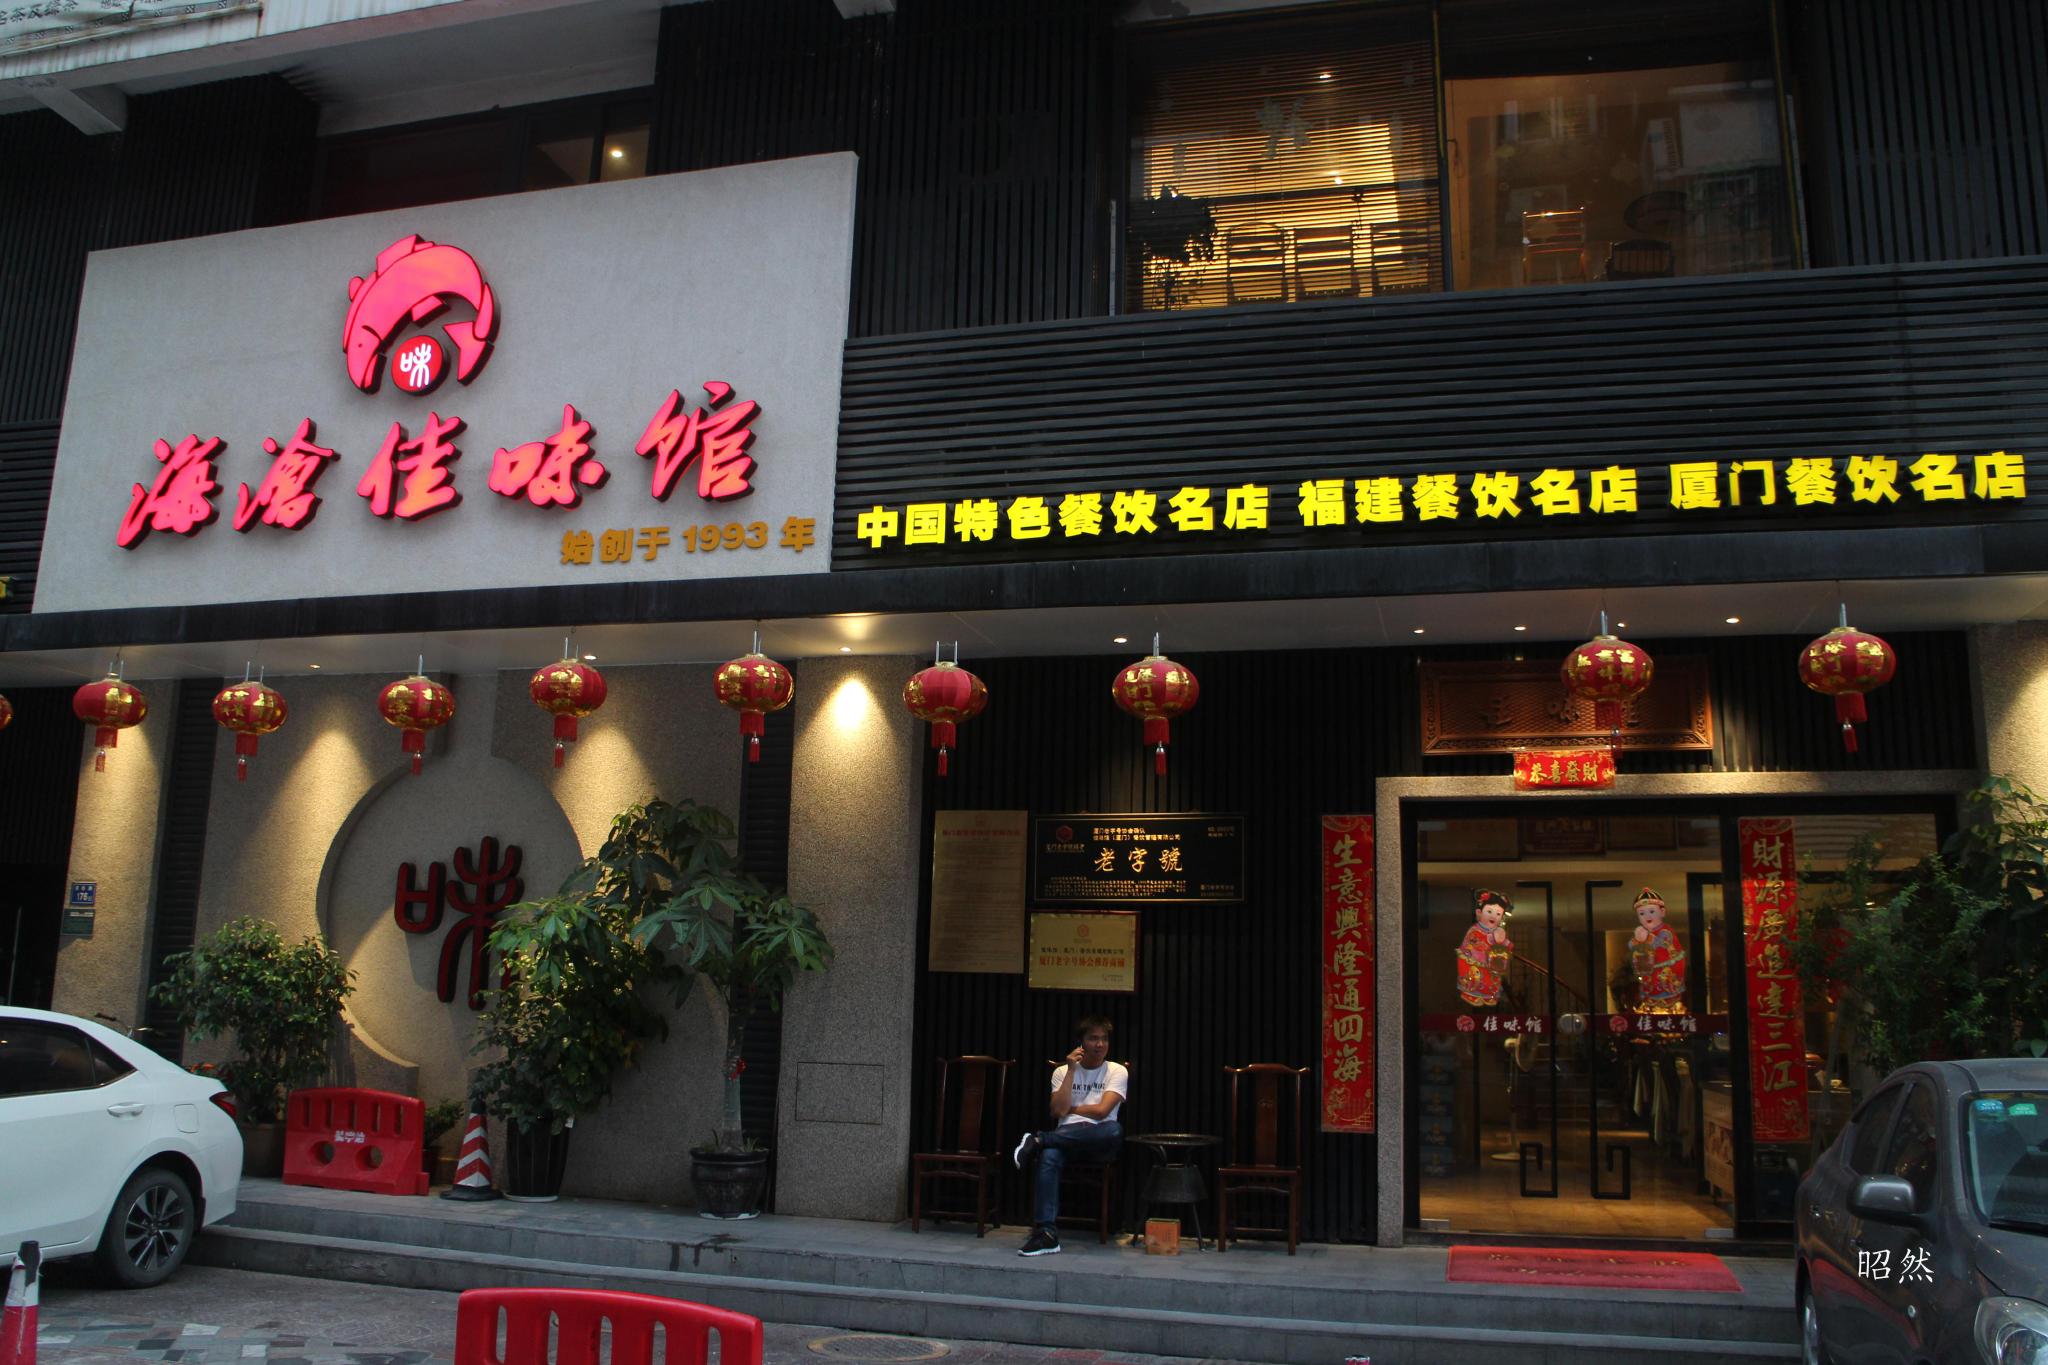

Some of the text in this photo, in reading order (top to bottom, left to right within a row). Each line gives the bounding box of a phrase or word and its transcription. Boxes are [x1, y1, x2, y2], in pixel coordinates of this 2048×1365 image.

[399, 343, 432, 388] 味
[857, 451, 2028, 549] 中国特色餐饮名店 福建餐饮名店 厦门餐饮名店
[561, 516, 816, 565] 始创于 1993 年
[1529, 760, 1598, 784] 恭喜發財
[1094, 846, 1183, 873] 老字號
[1330, 834, 1366, 1082] 生意興隆通四海
[1751, 836, 1798, 1093] 財源廣進達三江
[1483, 1015, 1698, 1033] 佳味馆 佳味馆
